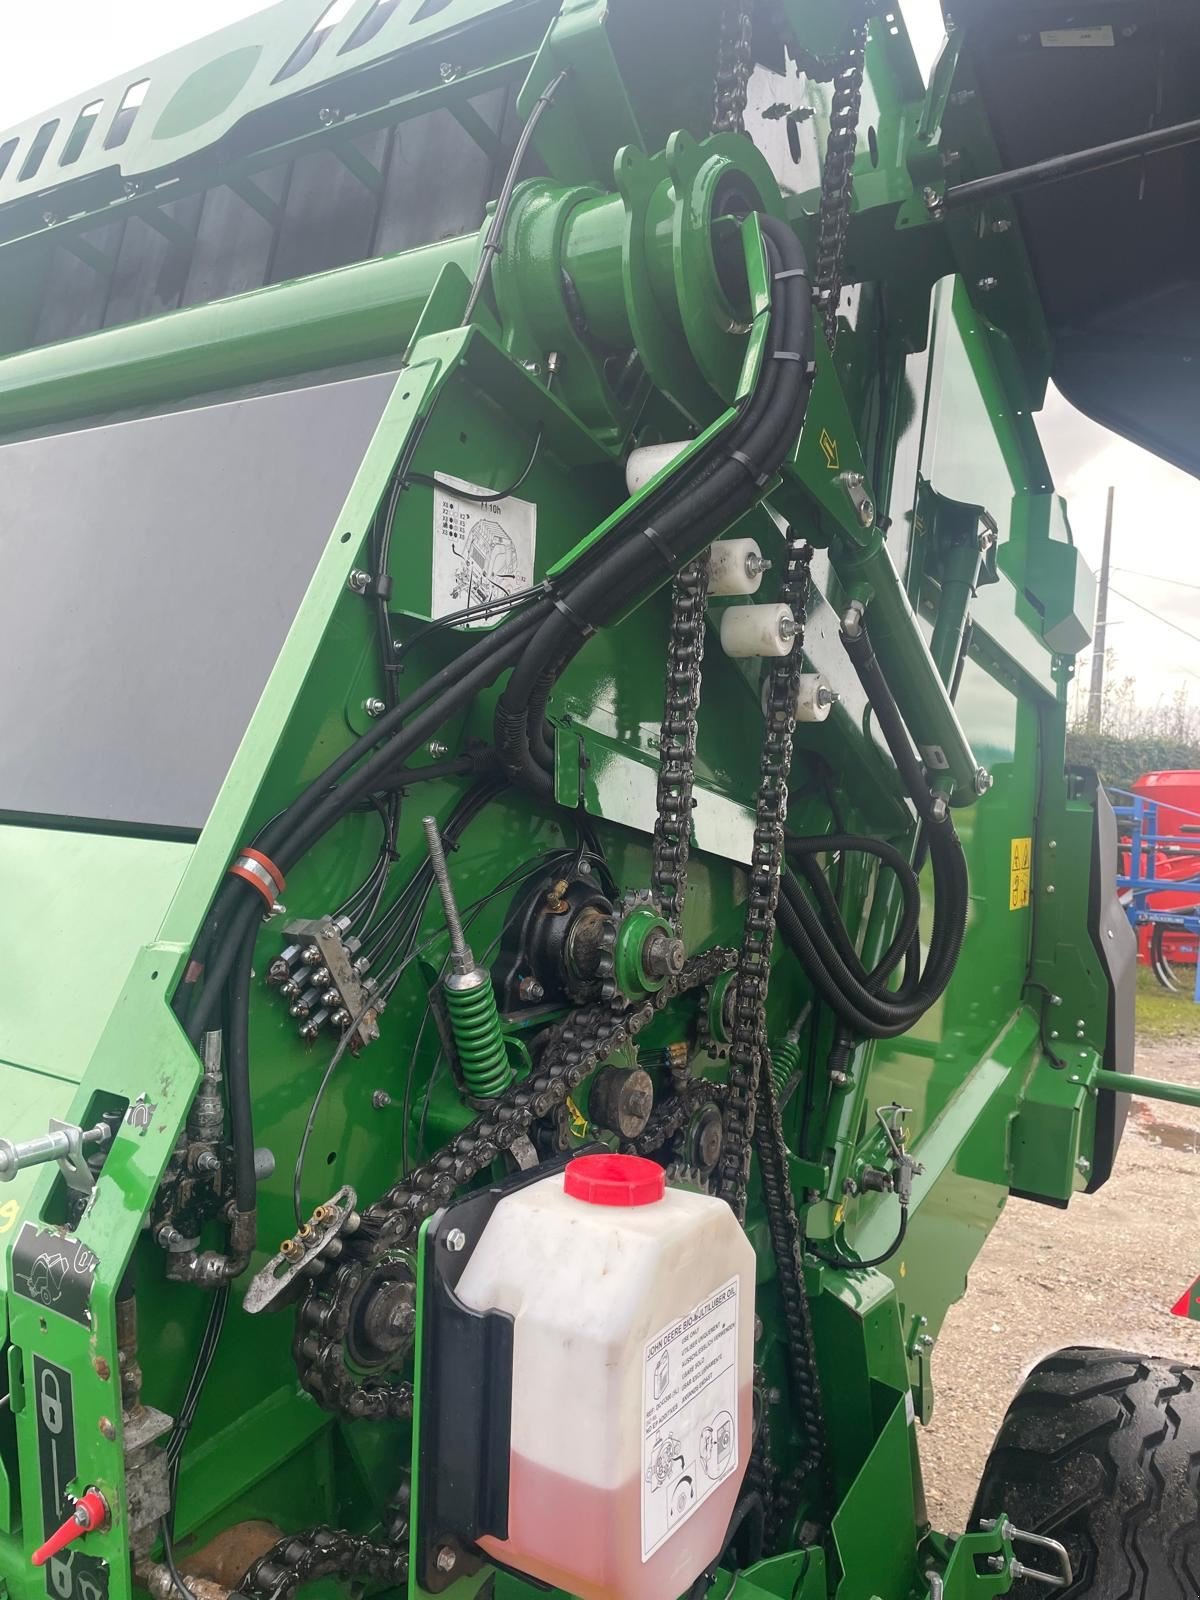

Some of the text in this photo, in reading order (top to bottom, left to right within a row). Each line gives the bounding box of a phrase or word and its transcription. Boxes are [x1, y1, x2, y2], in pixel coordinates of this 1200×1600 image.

[648, 1338, 663, 1359] JOHN
[663, 1324, 682, 1345] DEERE
[726, 1286, 736, 1298] OIL
